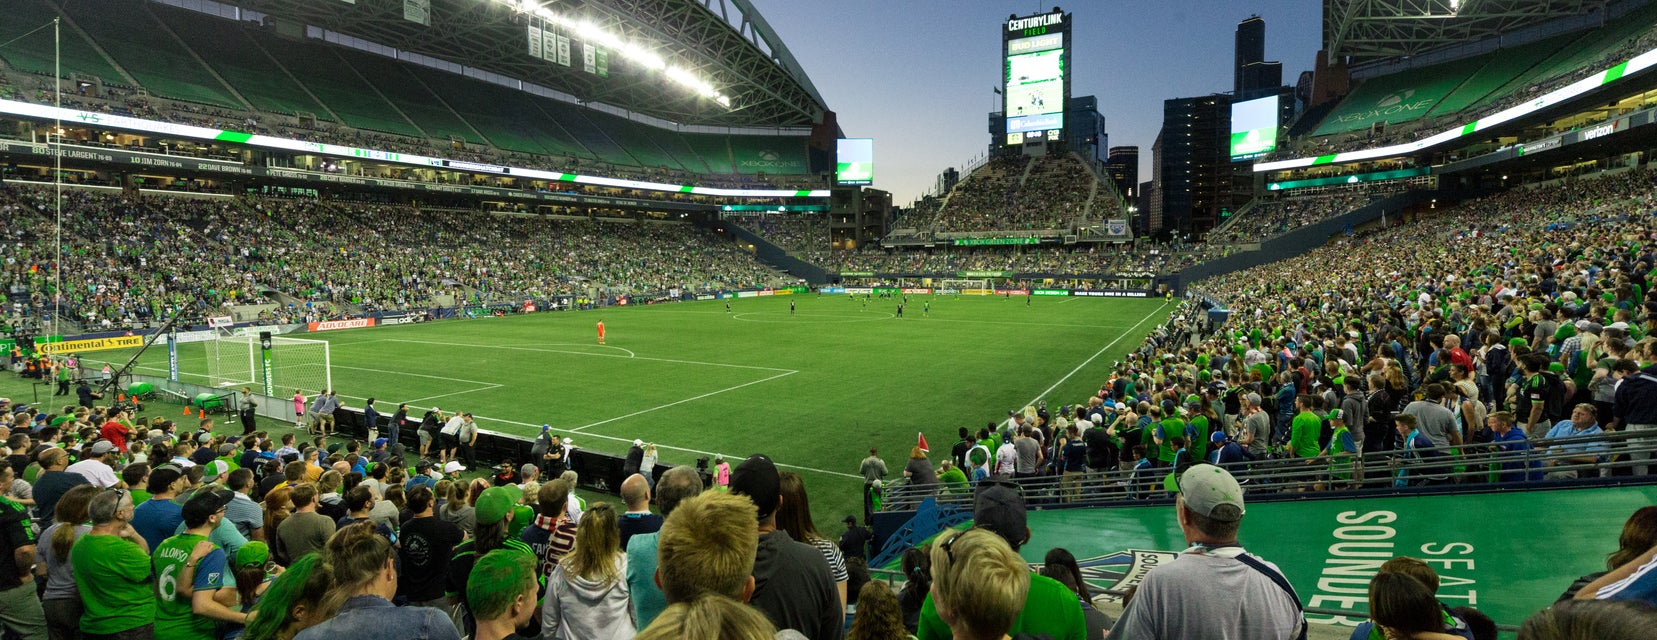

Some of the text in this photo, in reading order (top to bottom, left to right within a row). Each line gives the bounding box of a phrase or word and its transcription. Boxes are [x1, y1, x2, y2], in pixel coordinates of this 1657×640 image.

[1008, 13, 1062, 31] CENTURYLINK
[1024, 26, 1047, 36] FIELD
[1011, 37, 1059, 51] BUD LIGHT
[80, 112, 99, 123] VS
[1331, 98, 1433, 123] XBOX ONE
[1584, 124, 1613, 140] verizon
[45, 148, 66, 157] STEVE
[68, 150, 97, 160] LARGENT
[130, 156, 140, 164] 10
[141, 157, 153, 165] JIM
[153, 158, 169, 167] ZORN
[775, 160, 800, 168] ONE
[208, 164, 221, 172] DAVE
[221, 166, 240, 174] BROWN
[320, 319, 366, 331] ADVOCARE
[40, 340, 105, 353] Continental
[116, 338, 139, 346] TIRE
[160, 547, 188, 563] ALONSO
[1420, 542, 1477, 607] SEAT
[159, 564, 176, 601] 6
